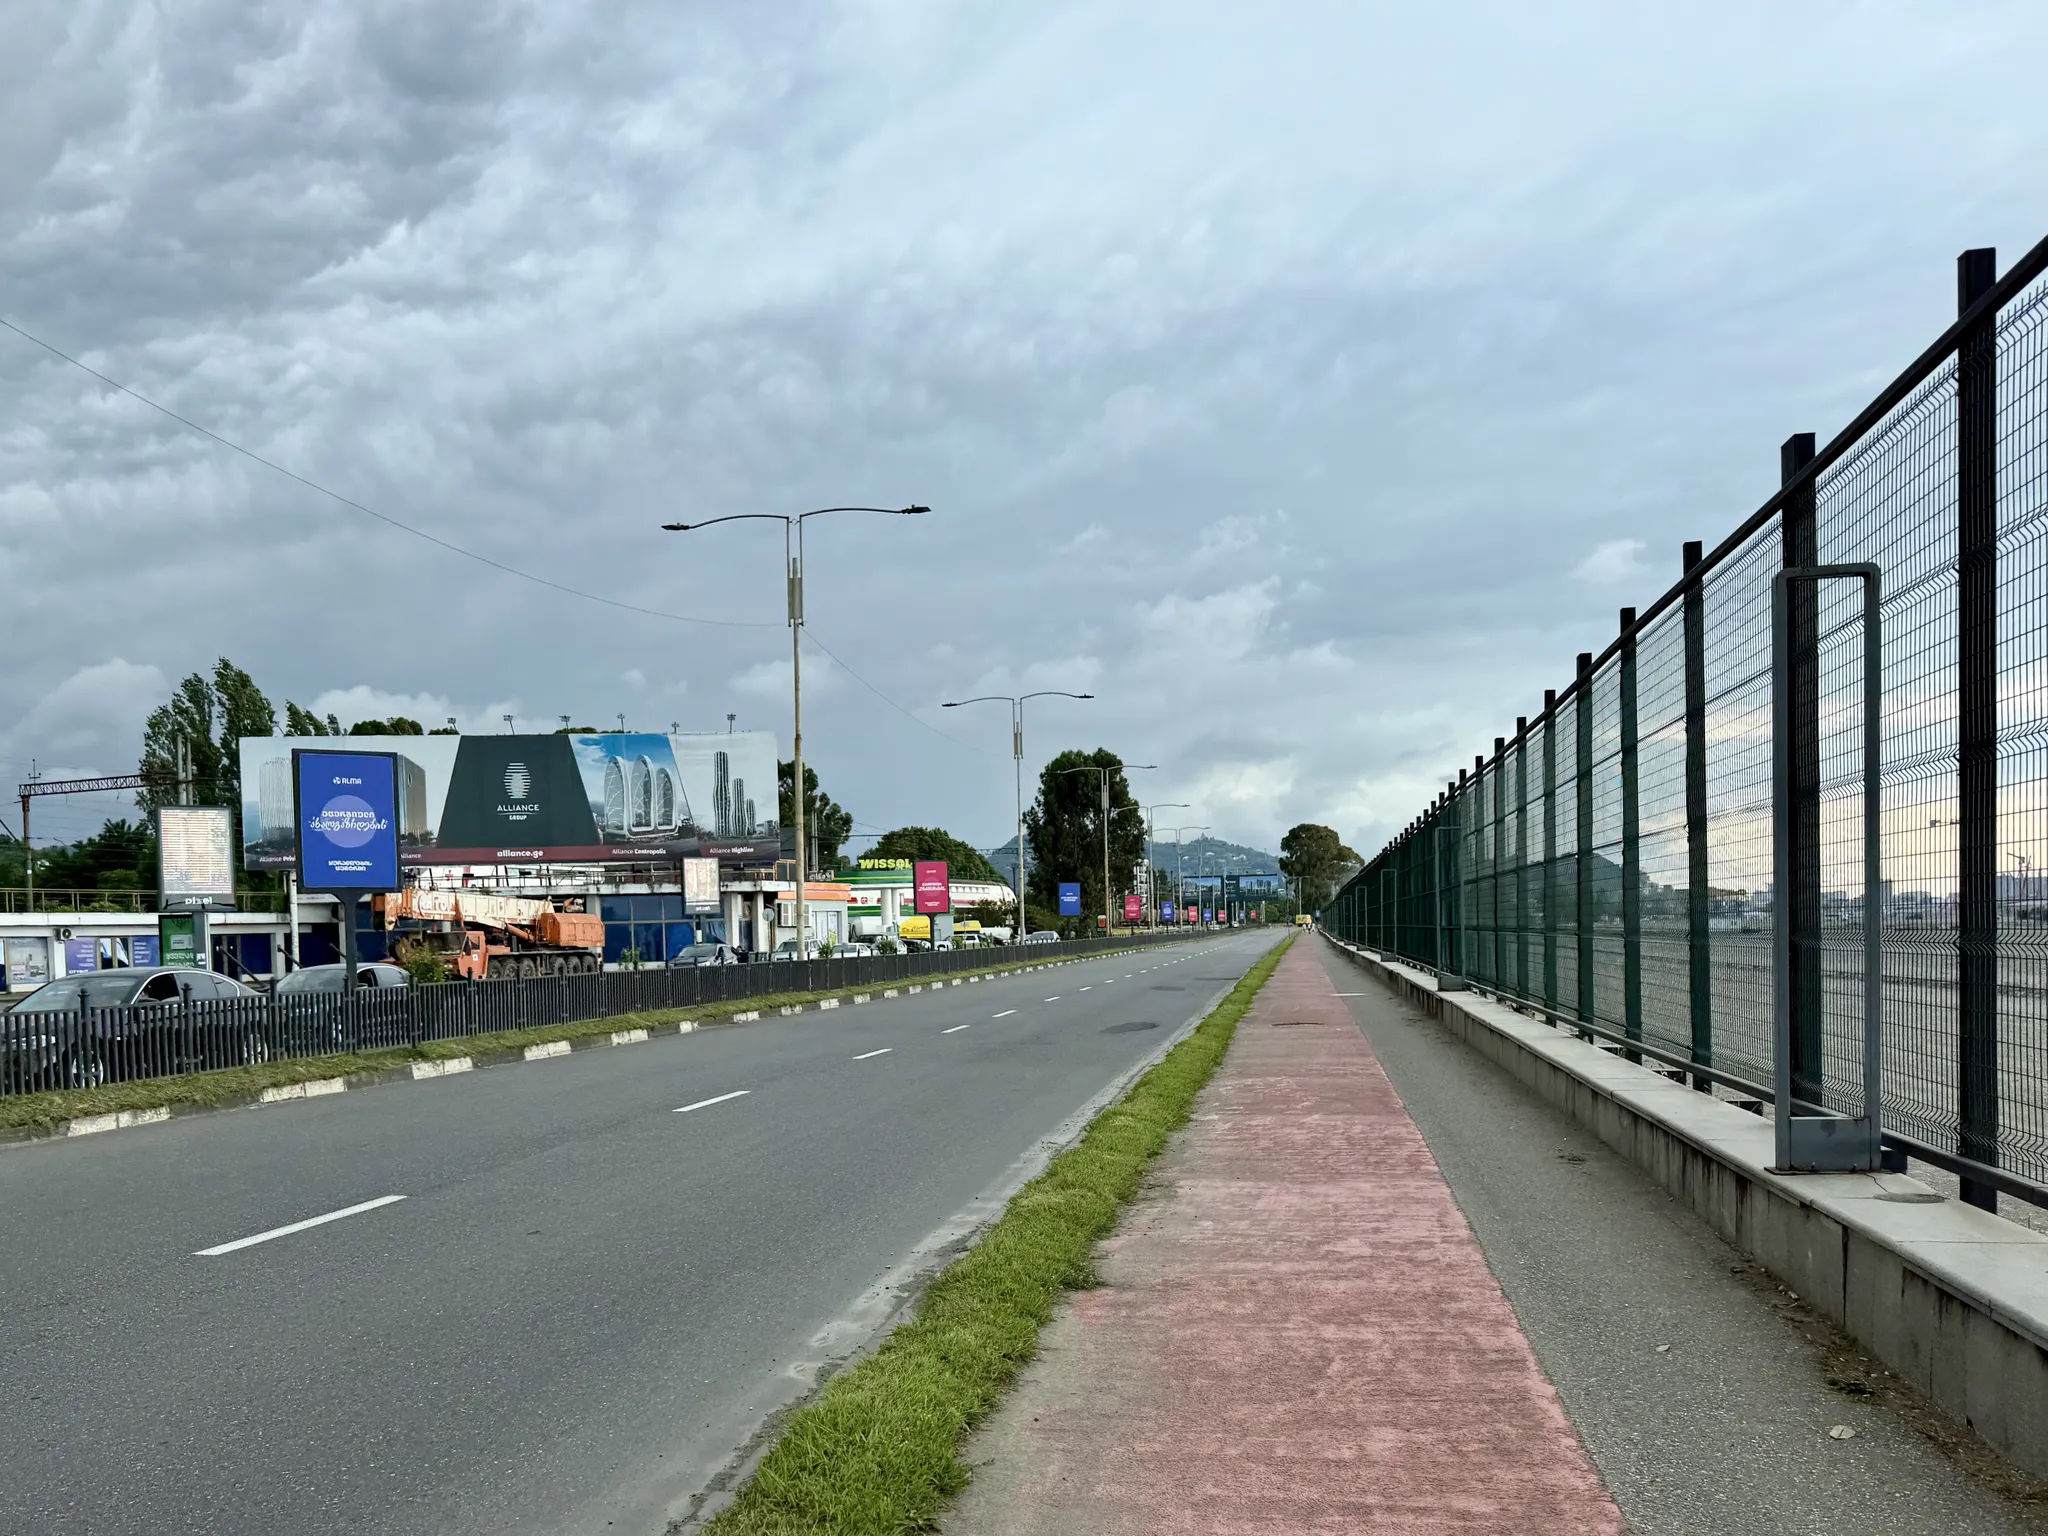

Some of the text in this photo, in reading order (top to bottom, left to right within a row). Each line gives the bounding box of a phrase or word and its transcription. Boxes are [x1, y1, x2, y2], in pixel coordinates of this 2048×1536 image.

[341, 777, 362, 785] ALMA
[496, 849, 544, 858] alliance.ge
[859, 859, 912, 869] WISSOL
